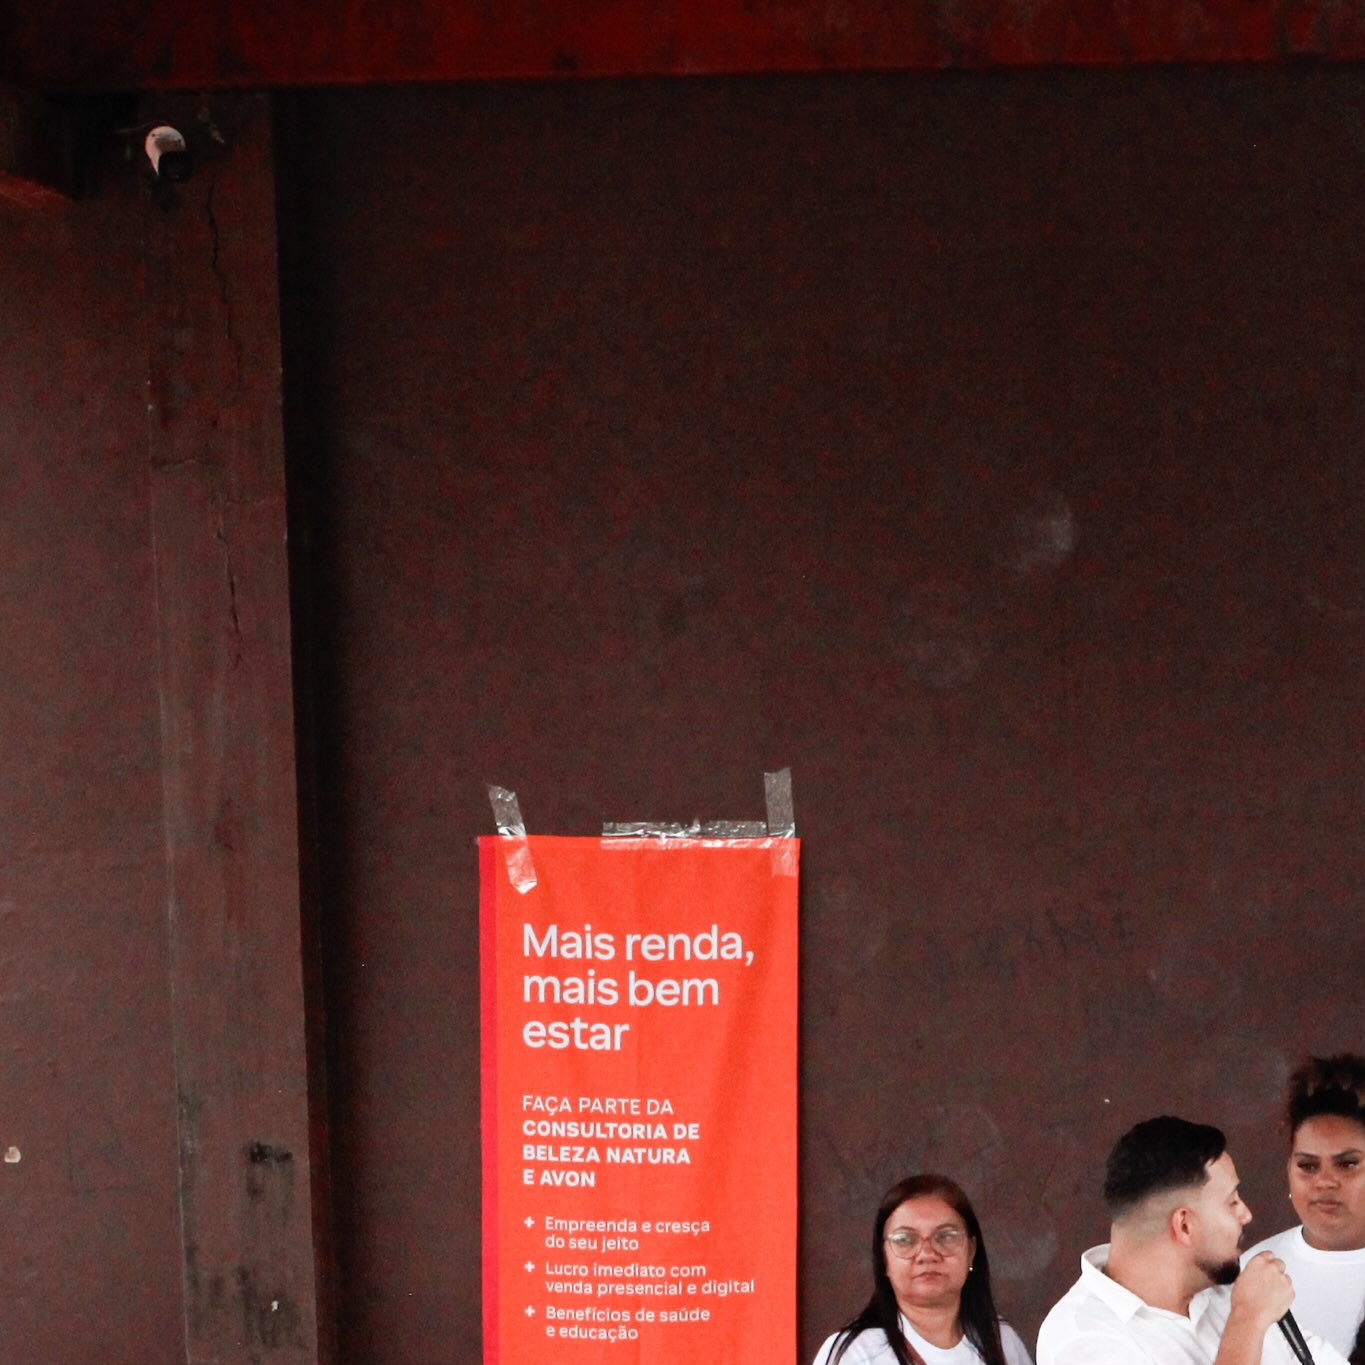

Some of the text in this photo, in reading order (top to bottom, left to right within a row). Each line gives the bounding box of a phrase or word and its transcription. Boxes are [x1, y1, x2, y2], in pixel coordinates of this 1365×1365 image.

[523, 923, 754, 965] Mais renda,
[523, 971, 719, 1006] mais bem
[523, 1018, 630, 1050] estar
[523, 1095, 673, 1116] FAÇA PARTE DA
[523, 1120, 699, 1140] CONSULTORIA DE
[523, 1144, 690, 1164] BELEZA NATURA
[523, 1169, 595, 1187] E AVON
[545, 1216, 710, 1237] Empreenda e cresça
[545, 1234, 639, 1253] do seu jeito
[546, 1262, 706, 1278] Lucro imediato com
[546, 1279, 755, 1297] venda presencial e digital
[546, 1306, 710, 1322] Benefícios de saúde
[546, 1325, 638, 1343] e educação
